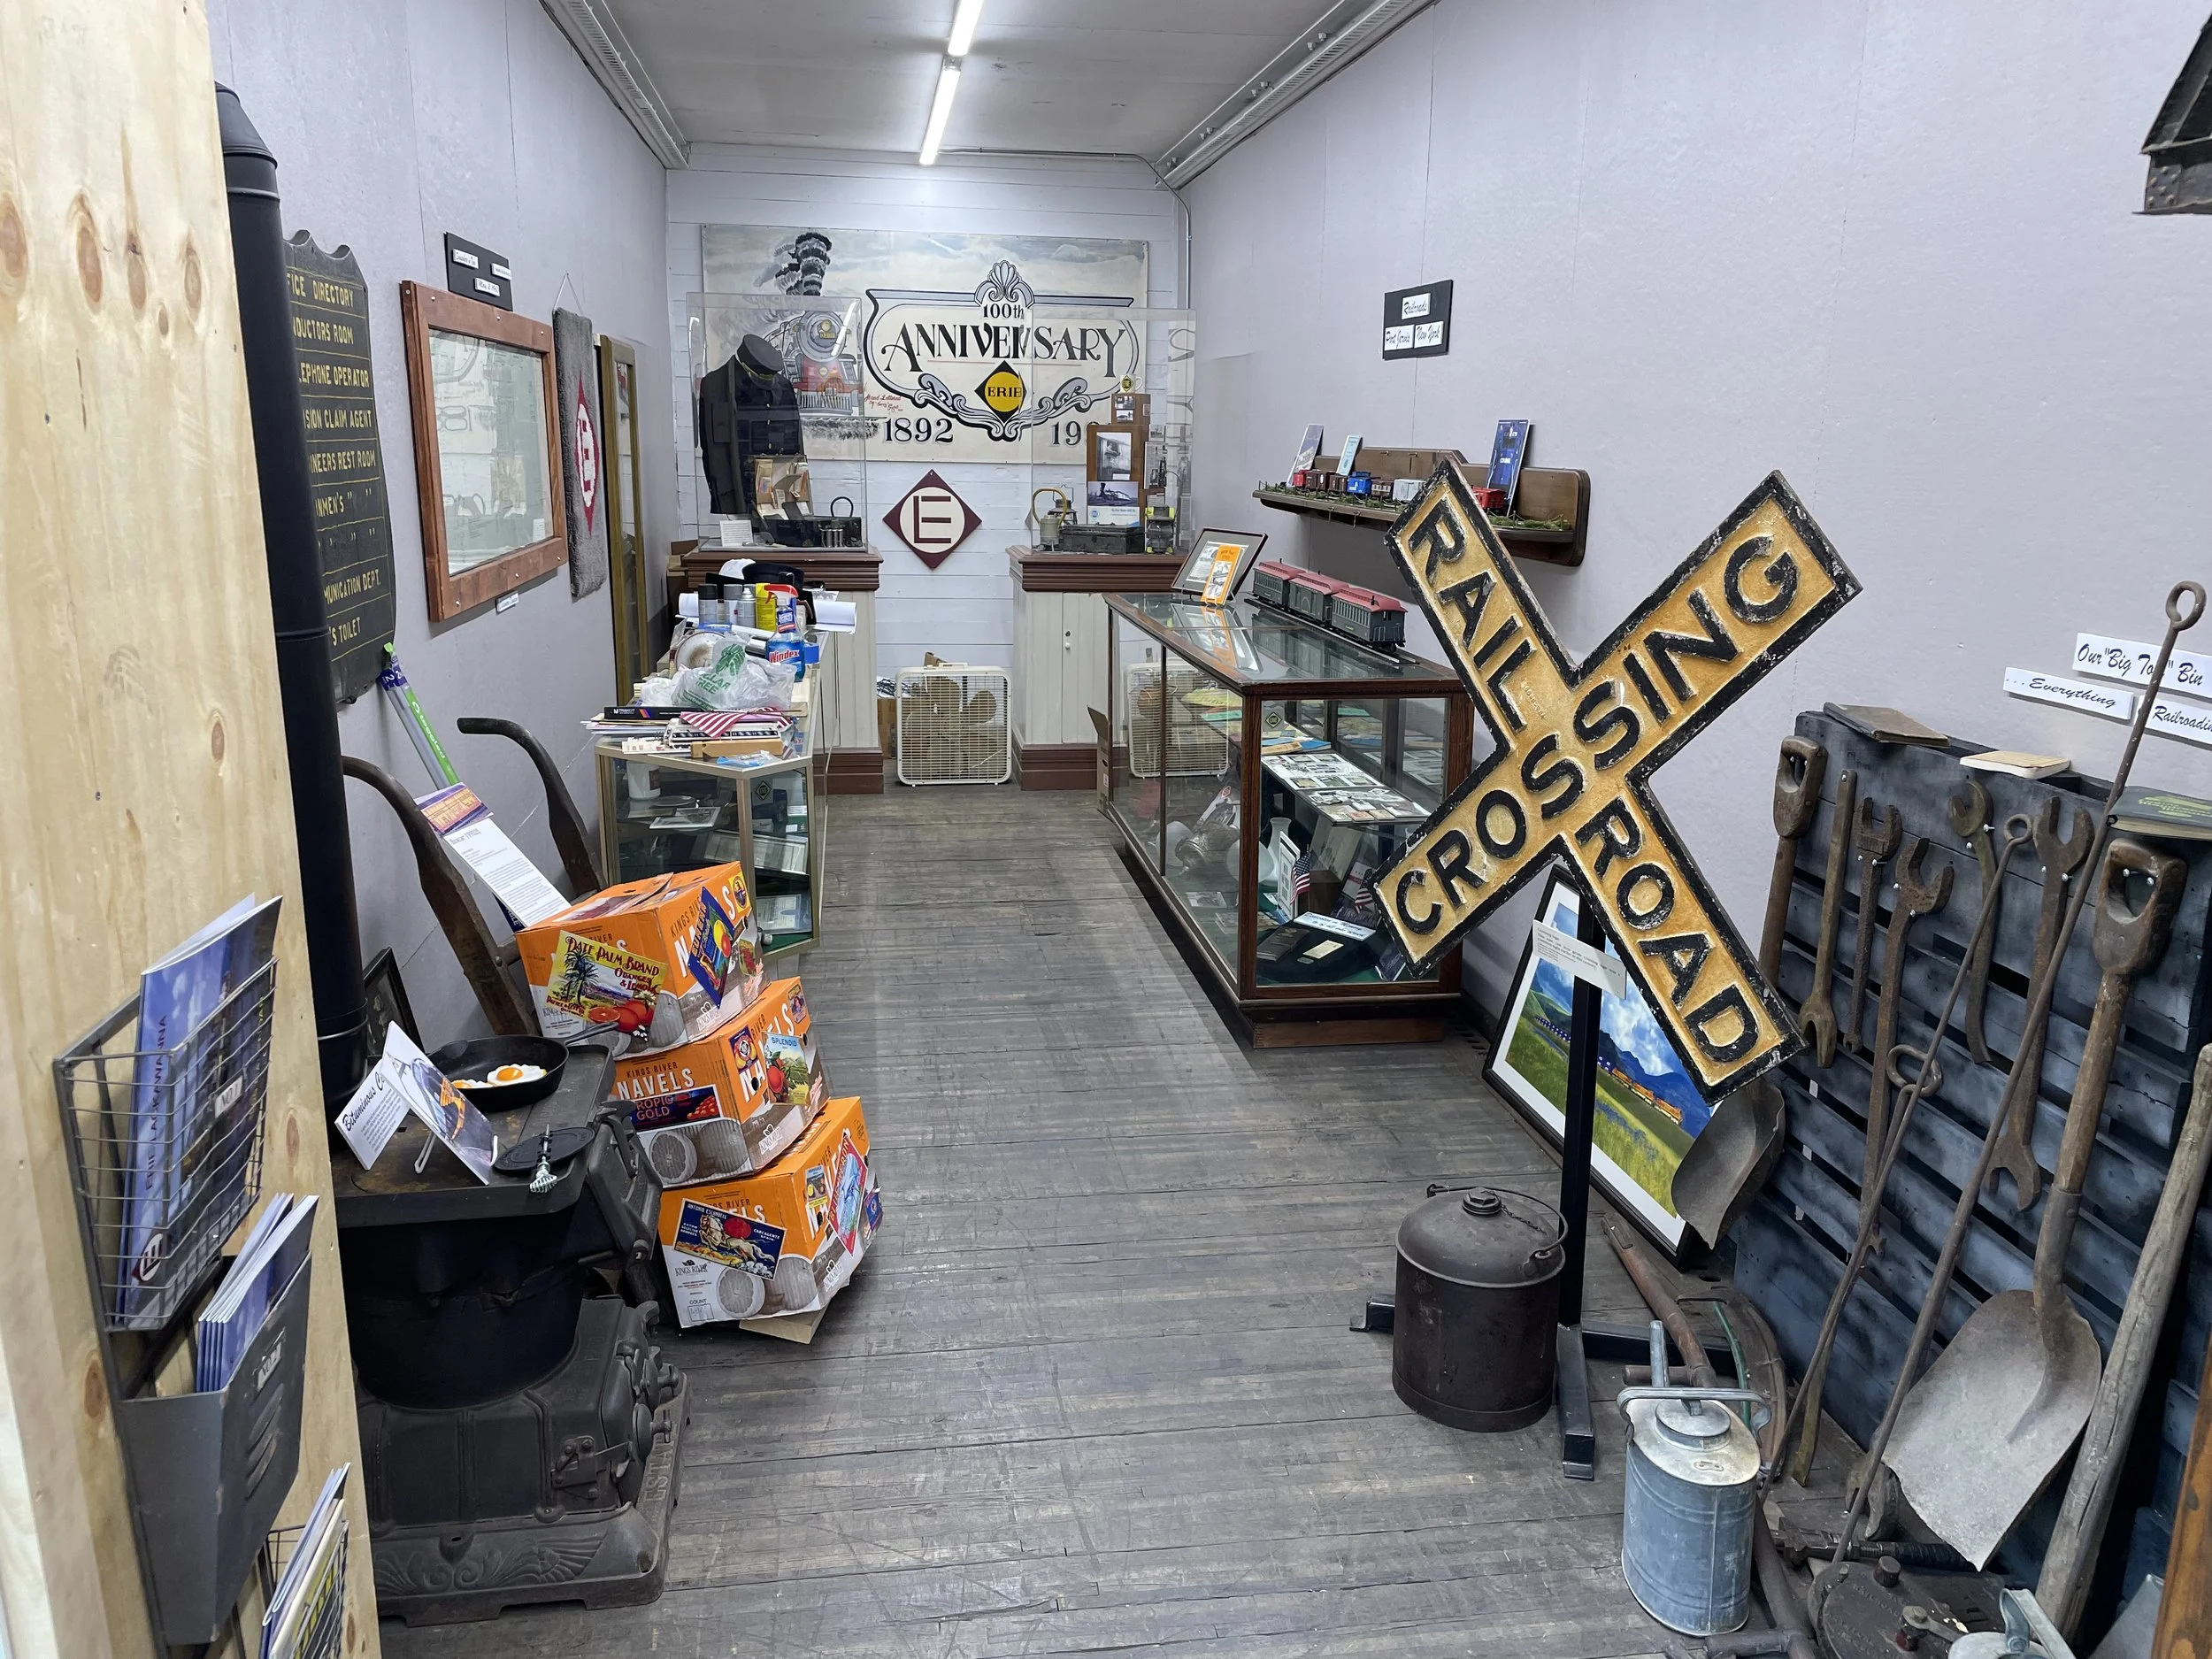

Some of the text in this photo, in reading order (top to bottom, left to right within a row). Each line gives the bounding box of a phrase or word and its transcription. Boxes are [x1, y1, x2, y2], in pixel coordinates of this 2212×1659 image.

[312, 280, 354, 308] DIRECTORY
[982, 303, 1025, 320] 100th
[333, 324, 354, 345] ROOM
[299, 361, 370, 388] EPHONE OPERATOR
[987, 387, 1023, 397] ERIE
[324, 410, 348, 429] CLAIM
[349, 410, 373, 428] AGENT
[885, 417, 954, 443] 1892
[337, 450, 356, 470] REST
[357, 449, 376, 467] ROOM
[913, 495, 953, 544] E
[362, 569, 381, 591] DEPT.
[338, 617, 361, 643] TOILET
[769, 649, 801, 664] Windex
[2078, 643, 2102, 664] Our
[2177, 662, 2203, 687] Bin
[2029, 678, 2116, 709] Everything
[1395, 535, 1800, 935] CROSSING
[1409, 495, 1537, 733] RAIL
[1575, 798, 1761, 1063] ROAD
[565, 936, 595, 956] DATE
[595, 946, 623, 965] PALM
[623, 954, 660, 976] BRAND
[619, 979, 627, 987] &
[771, 1035, 797, 1048] SPLENDID
[626, 1062, 678, 1079] KINGS RIVER
[617, 1068, 695, 1101] NAVELS
[342, 1087, 377, 1132] Bituminous
[636, 1107, 671, 1121] GOLD
